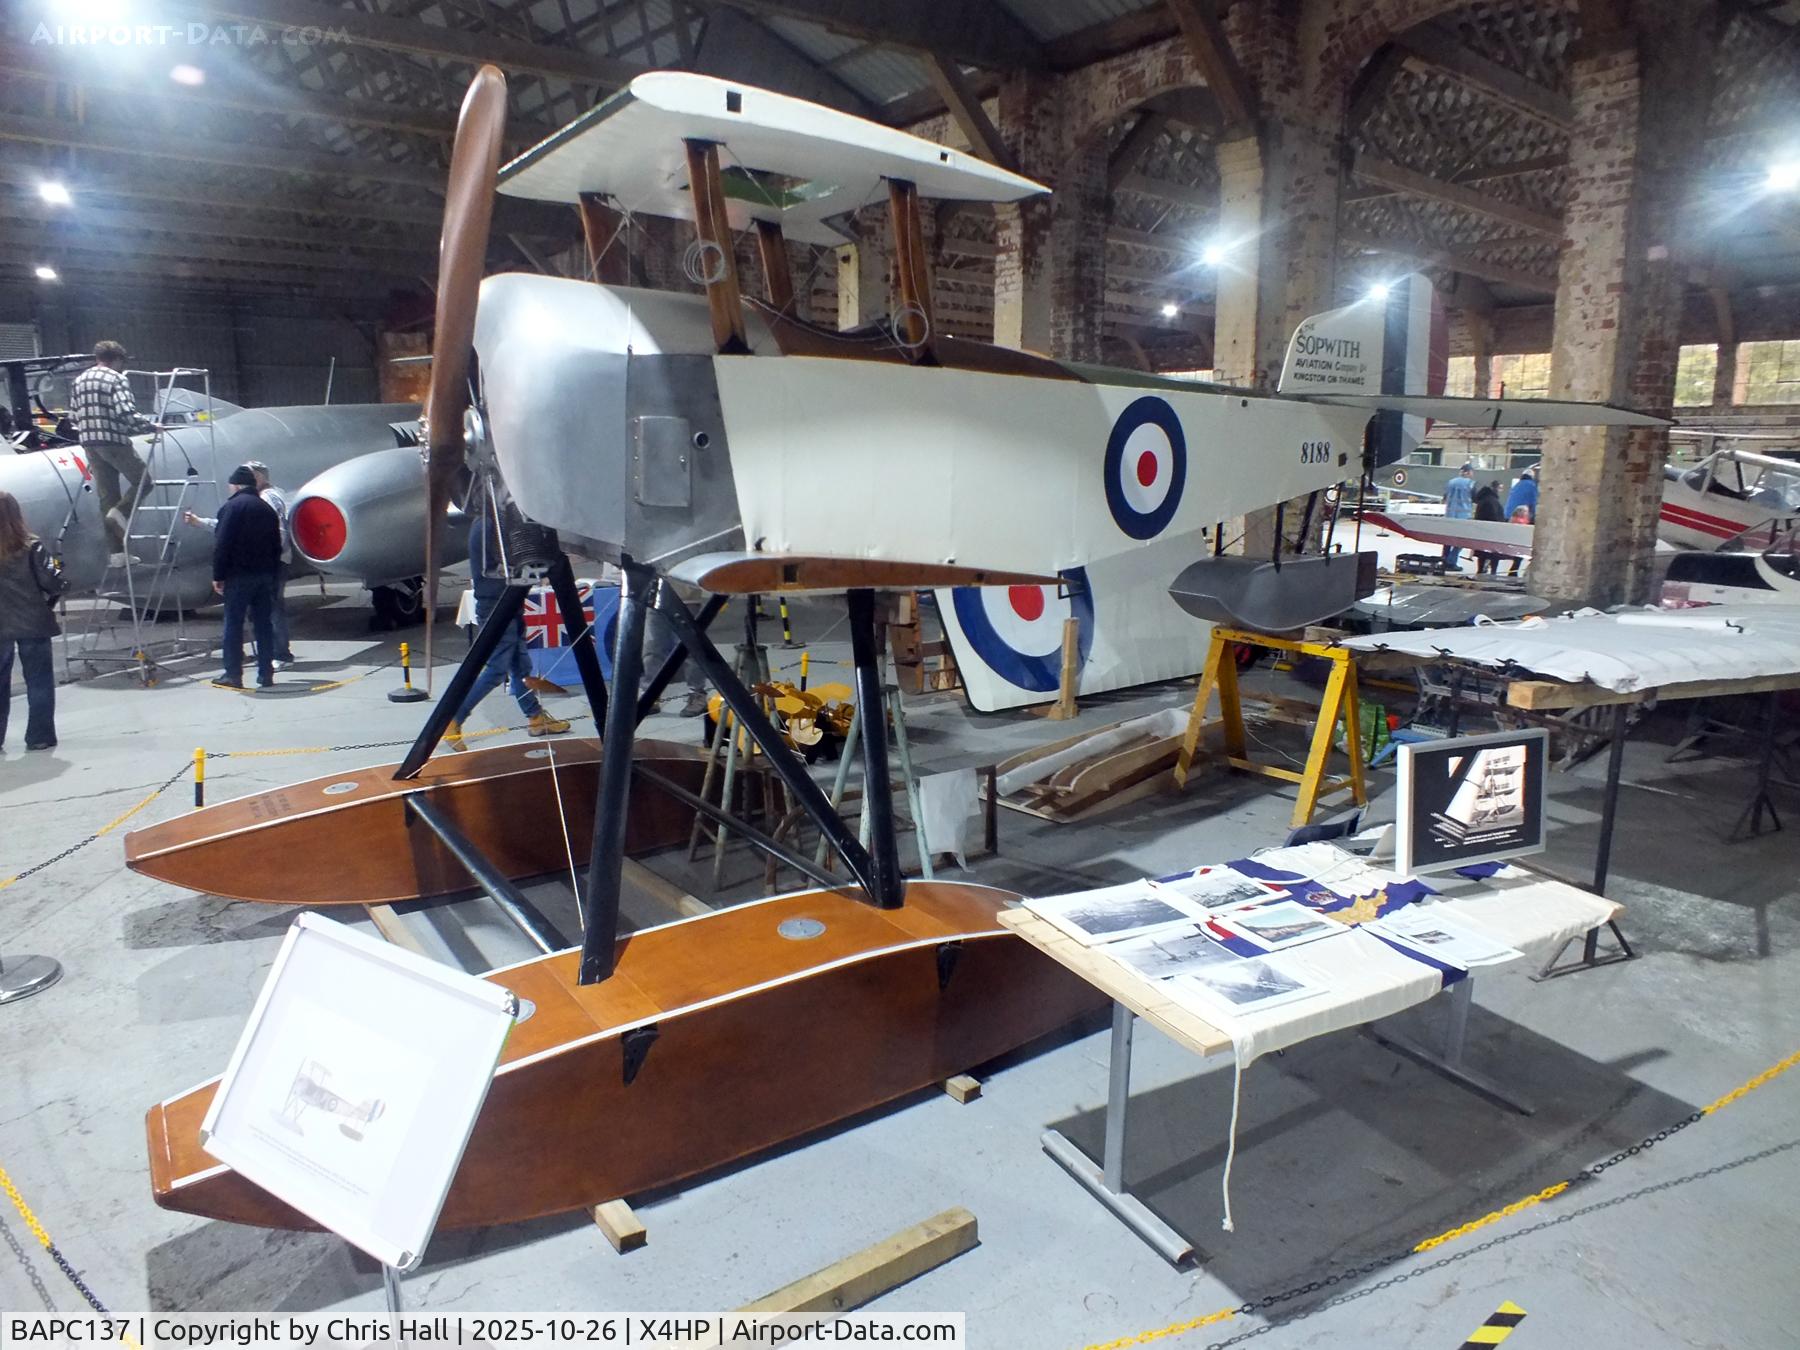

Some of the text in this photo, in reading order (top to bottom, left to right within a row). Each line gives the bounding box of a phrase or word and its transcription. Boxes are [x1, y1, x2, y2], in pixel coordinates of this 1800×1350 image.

[1296, 335, 1360, 358] SOPWITH
[1295, 358, 1333, 371] AVIATION
[1293, 372, 1326, 383] KINGSTON
[1300, 441, 1331, 464] 8188
